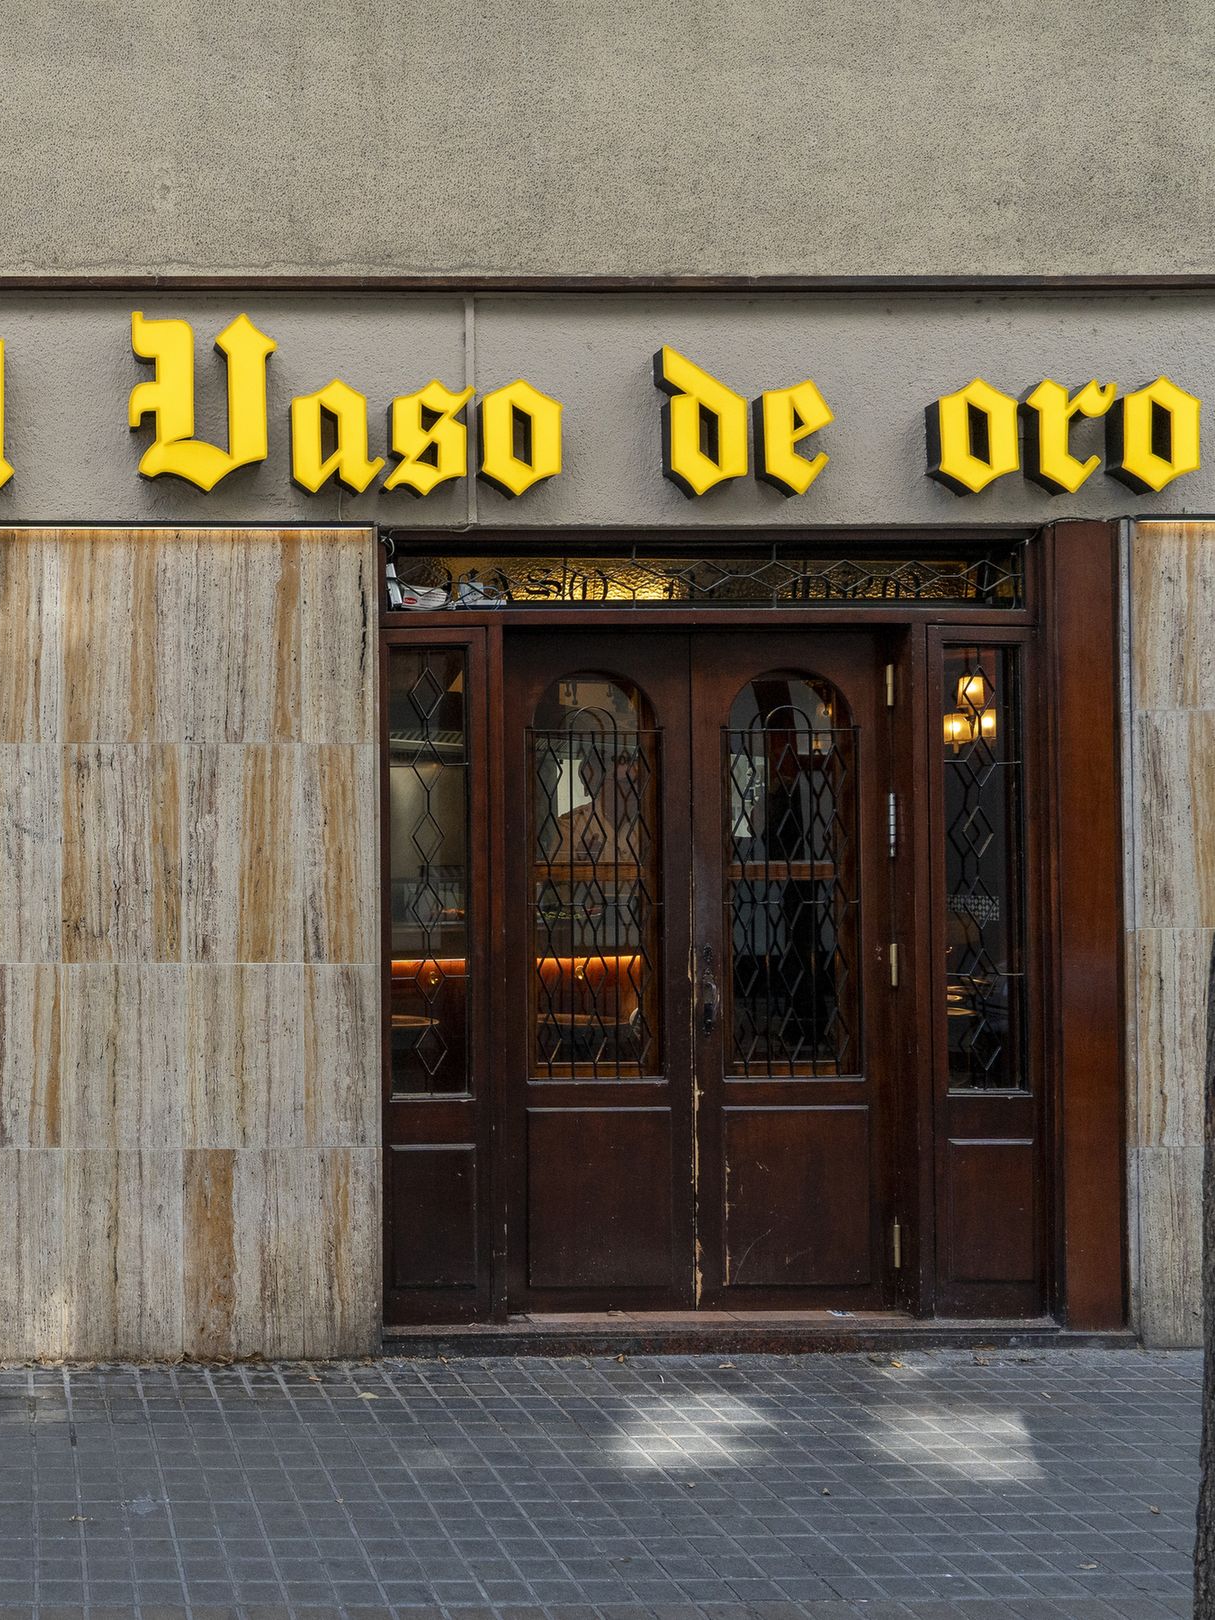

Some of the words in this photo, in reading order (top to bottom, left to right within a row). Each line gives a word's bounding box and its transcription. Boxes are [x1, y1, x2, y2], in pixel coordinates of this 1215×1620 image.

[128, 311, 565, 496] Vaso
[660, 344, 836, 495] de
[934, 375, 1202, 494] oro
